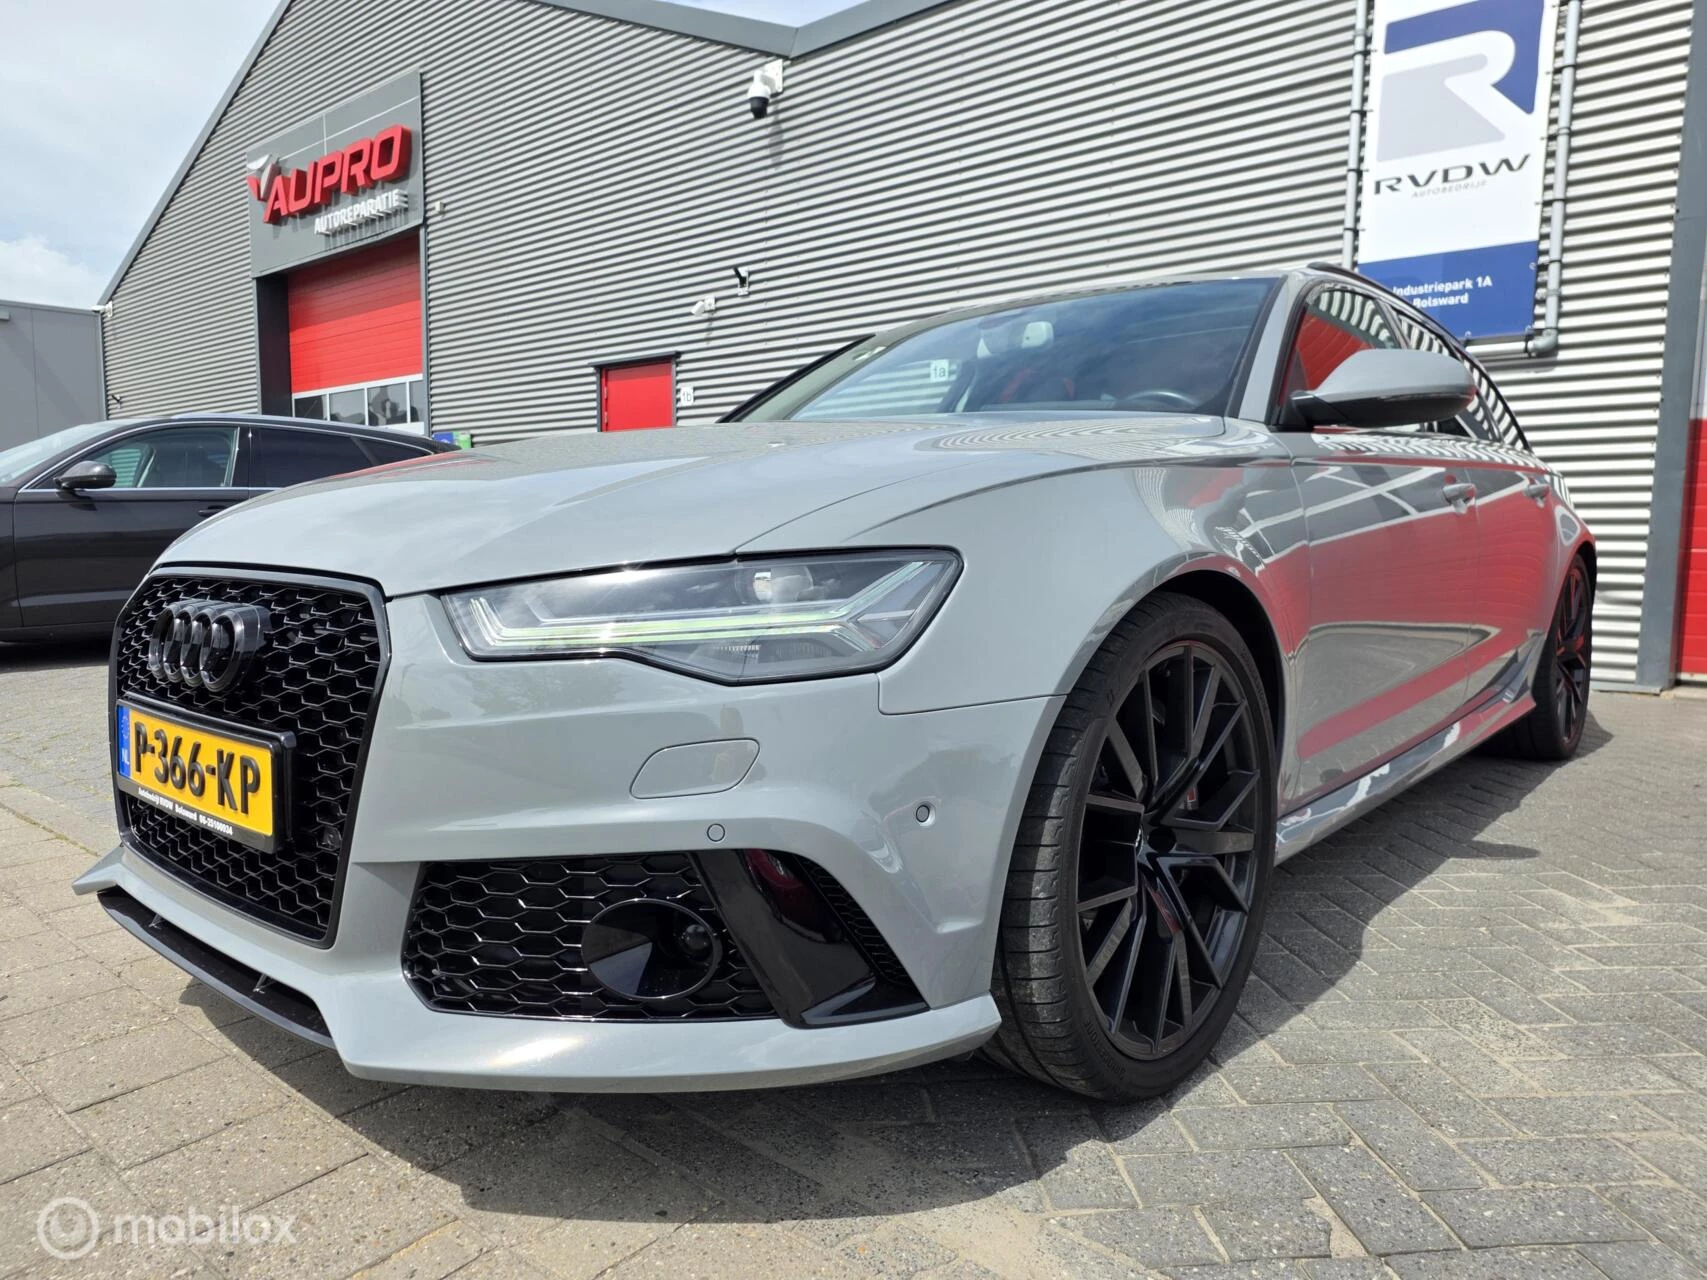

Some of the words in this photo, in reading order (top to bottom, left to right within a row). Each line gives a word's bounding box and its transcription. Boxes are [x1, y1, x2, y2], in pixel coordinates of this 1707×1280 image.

[1374, 154, 1530, 195] RVDW
[314, 188, 403, 235] AUTOREPARATIE
[1392, 278, 1473, 297] Industriepark
[1476, 275, 1493, 288] 1A
[121, 747, 130, 765] NL
[134, 721, 261, 815] P-366-KP
